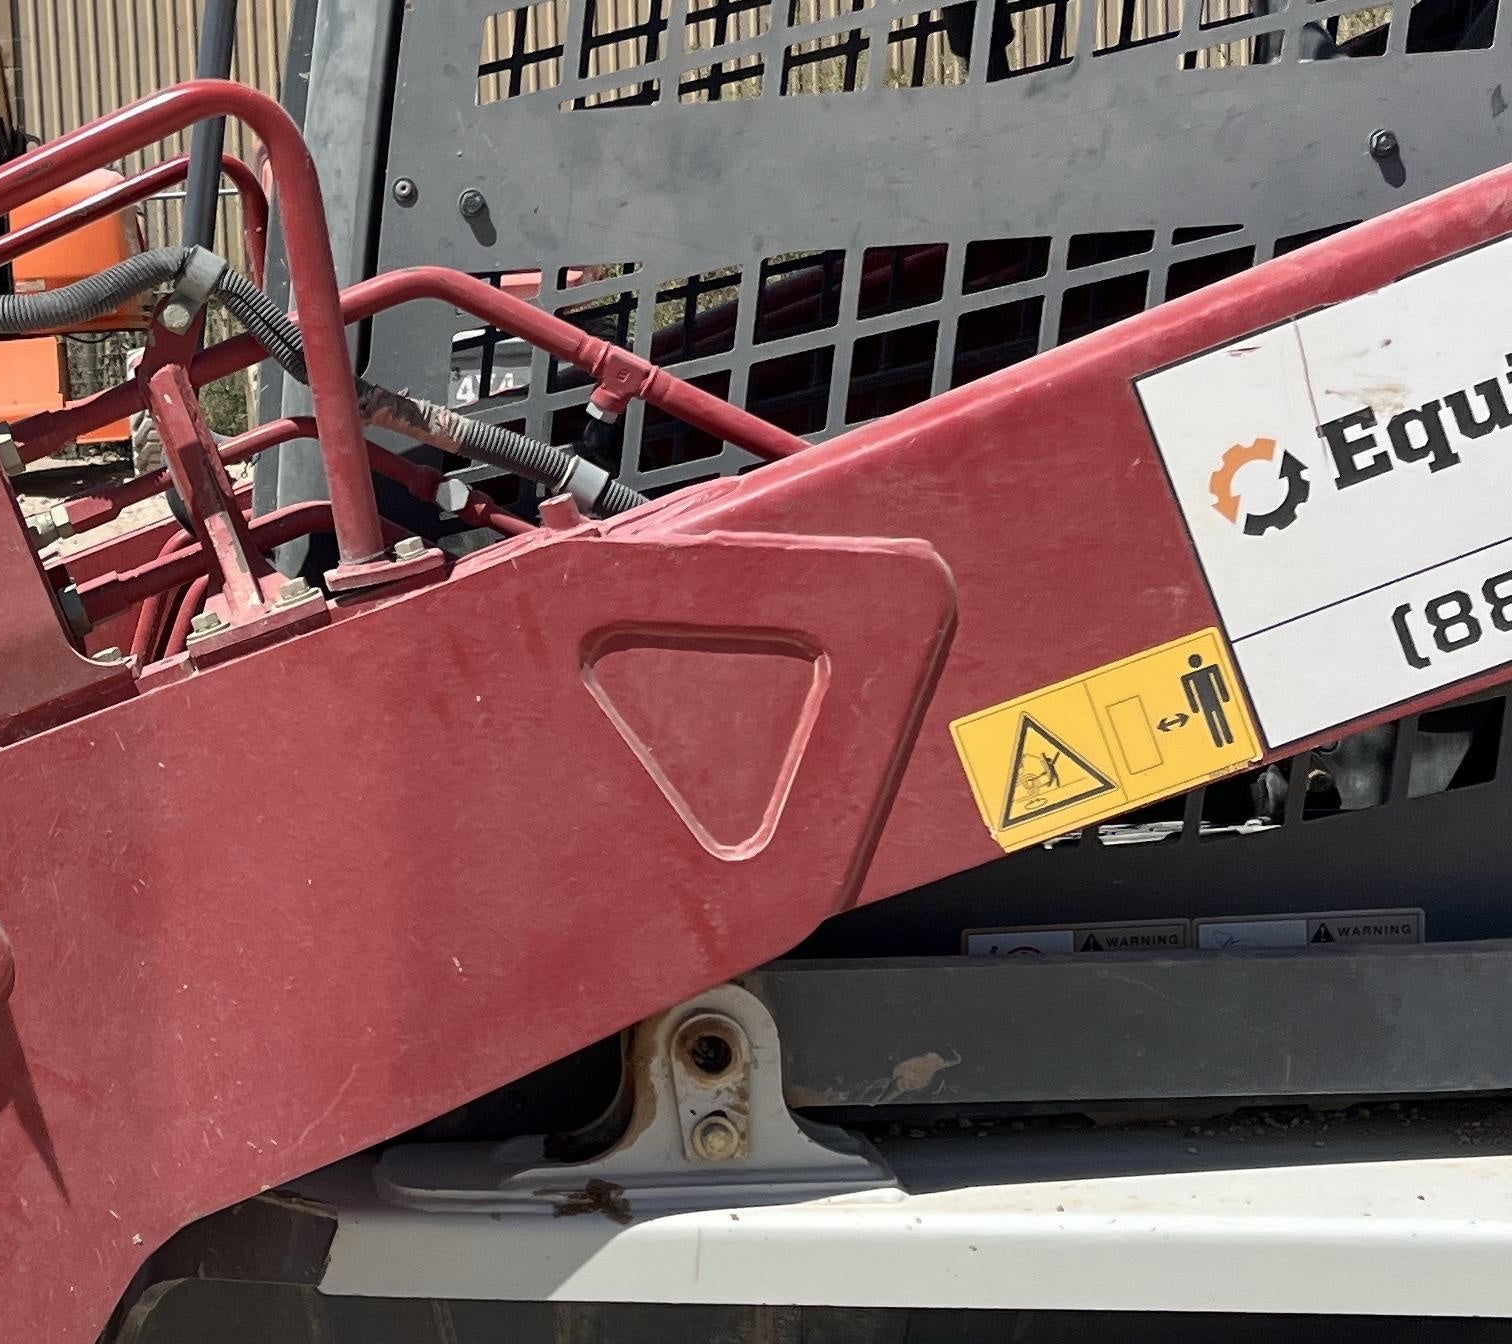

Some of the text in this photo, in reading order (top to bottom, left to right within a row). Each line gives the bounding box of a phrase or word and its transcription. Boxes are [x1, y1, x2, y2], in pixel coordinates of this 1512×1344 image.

[1316, 352, 1512, 490] Equ
[1337, 923, 1413, 937] WARNING
[1104, 933, 1180, 949] WARNING
